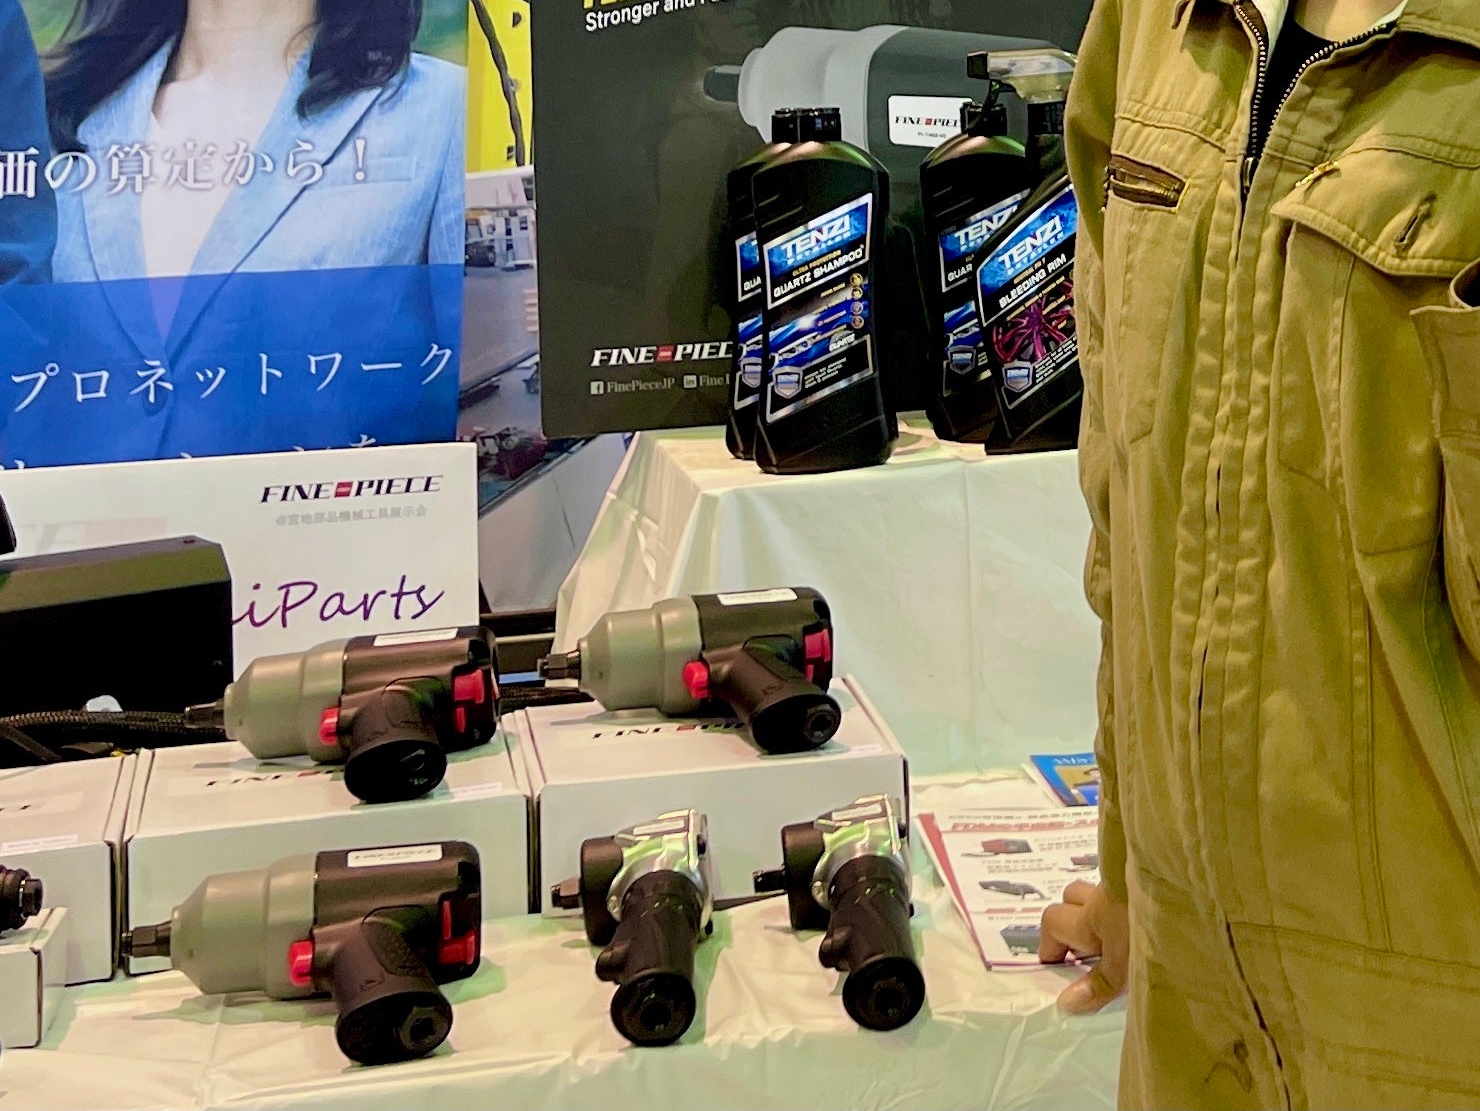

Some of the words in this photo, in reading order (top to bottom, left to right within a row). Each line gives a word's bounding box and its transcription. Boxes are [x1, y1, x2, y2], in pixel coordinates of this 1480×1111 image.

[585, 1, 660, 32] Stronger
[781, 214, 851, 259] TENZI
[998, 215, 1063, 270] TENZI
[773, 272, 812, 298] QUARTZ
[813, 248, 864, 279] SHAMPOO
[999, 268, 1047, 308] BLEEDING
[1047, 253, 1067, 273] RIM
[11, 343, 453, 413] プロネットワーク
[590, 346, 657, 367] FINE
[259, 481, 334, 503] FINE
[354, 474, 444, 497] PIECE
